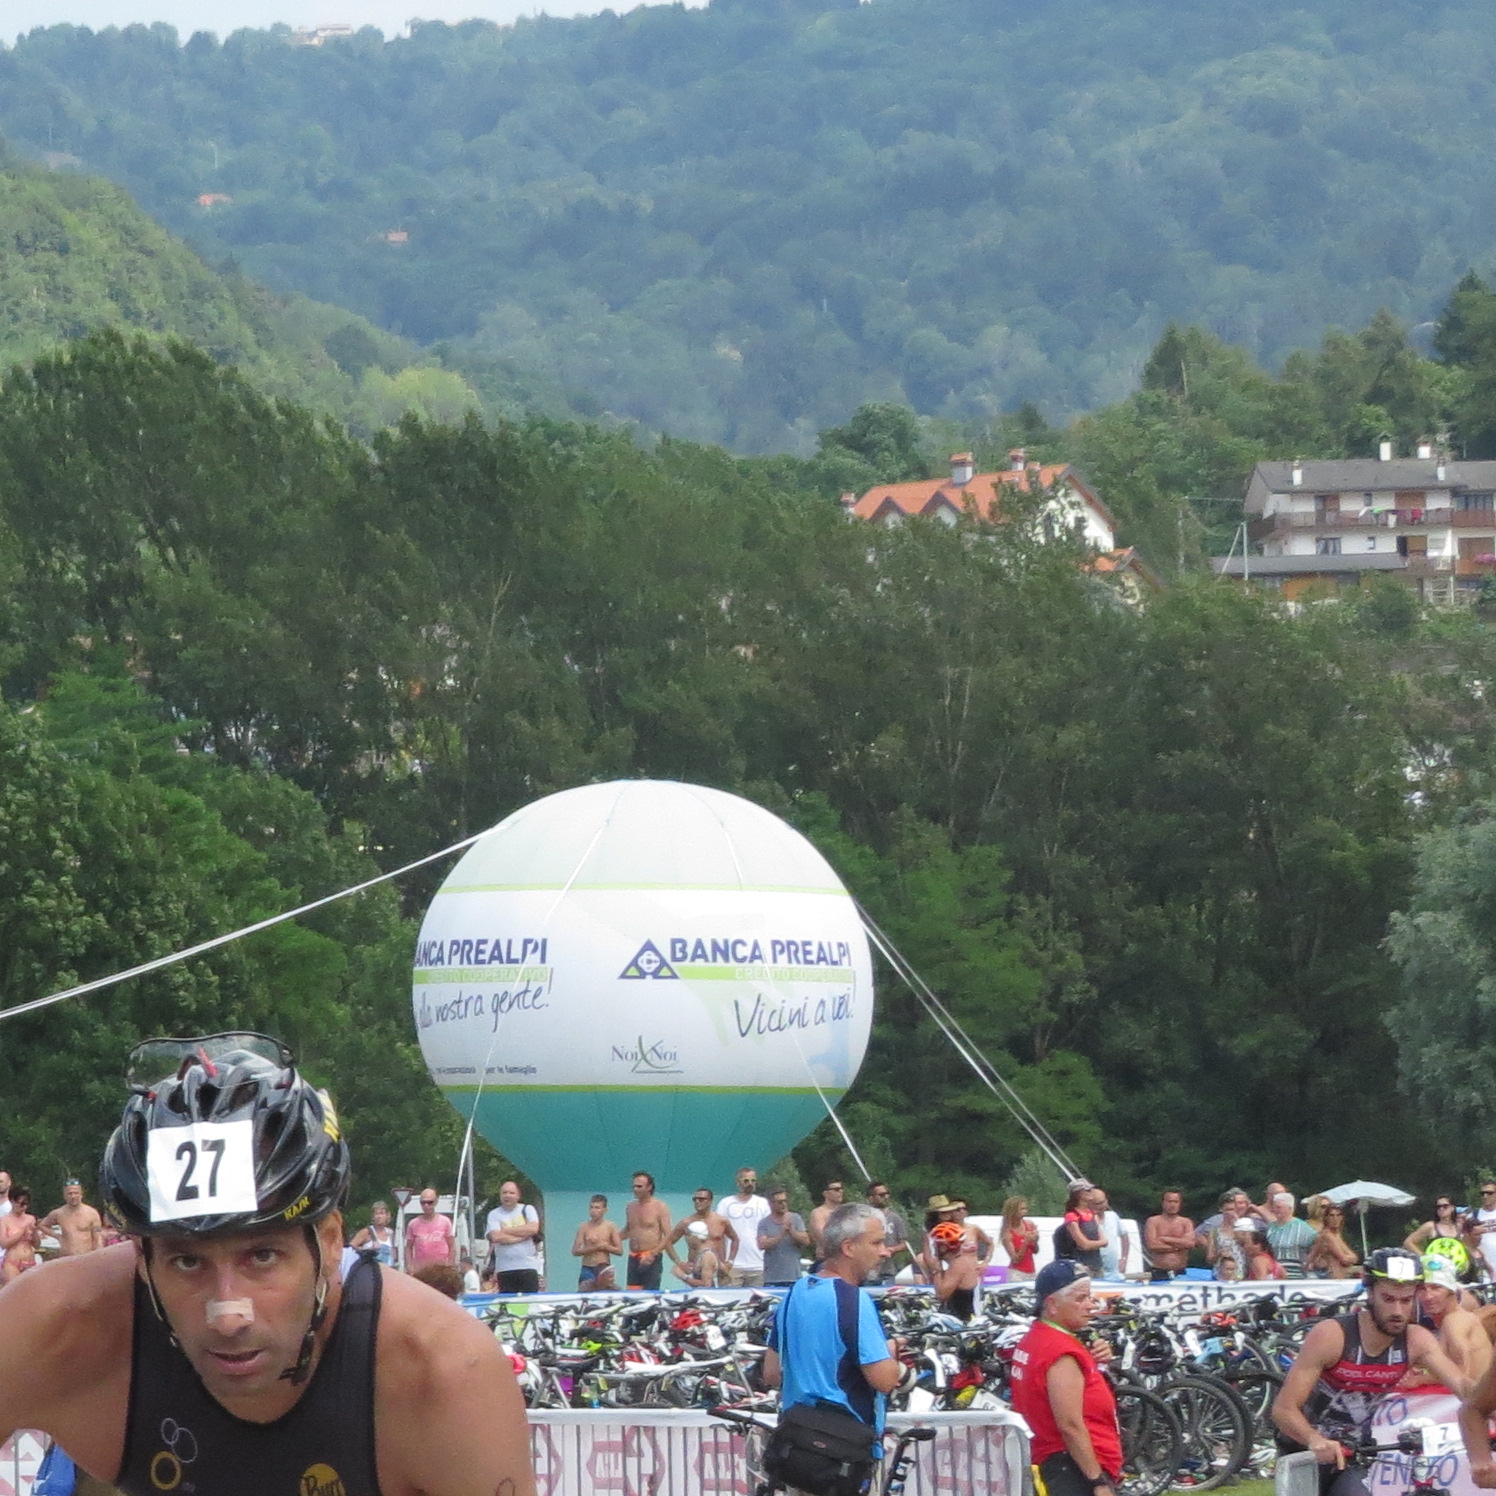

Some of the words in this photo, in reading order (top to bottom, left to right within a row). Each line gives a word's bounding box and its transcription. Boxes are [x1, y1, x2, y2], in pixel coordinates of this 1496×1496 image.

[414, 940, 444, 967] ANCA
[448, 938, 547, 965] PREALPI
[670, 937, 766, 963] BANCA
[770, 939, 852, 966] PREALPI
[734, 993, 809, 1039] Vicini
[814, 1000, 827, 1026] a
[175, 1138, 226, 1201] 27
[1440, 1427, 1448, 1441] 7
